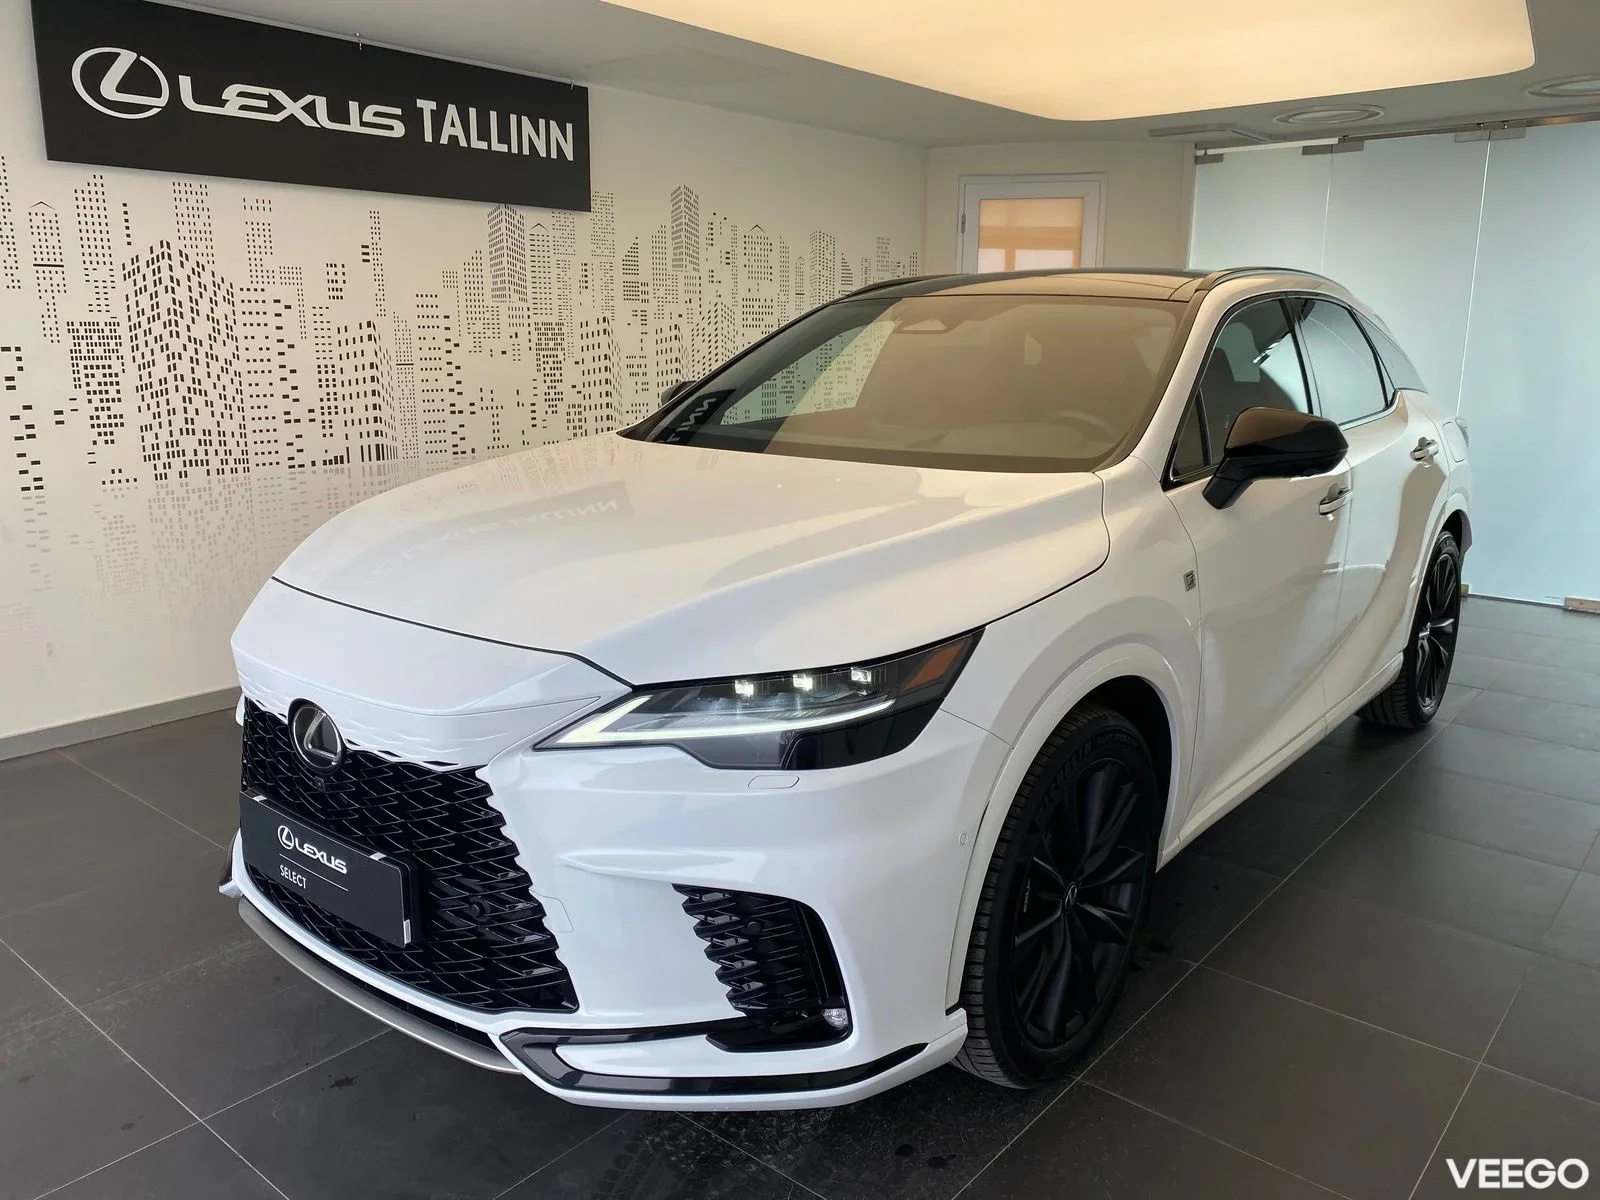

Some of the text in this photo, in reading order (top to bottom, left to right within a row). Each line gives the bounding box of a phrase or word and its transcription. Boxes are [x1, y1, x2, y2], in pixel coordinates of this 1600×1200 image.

[178, 74, 406, 138] LEXUS
[416, 98, 574, 161] TALLINN
[295, 837, 348, 874] LEXUS
[279, 864, 307, 889] SELECT
